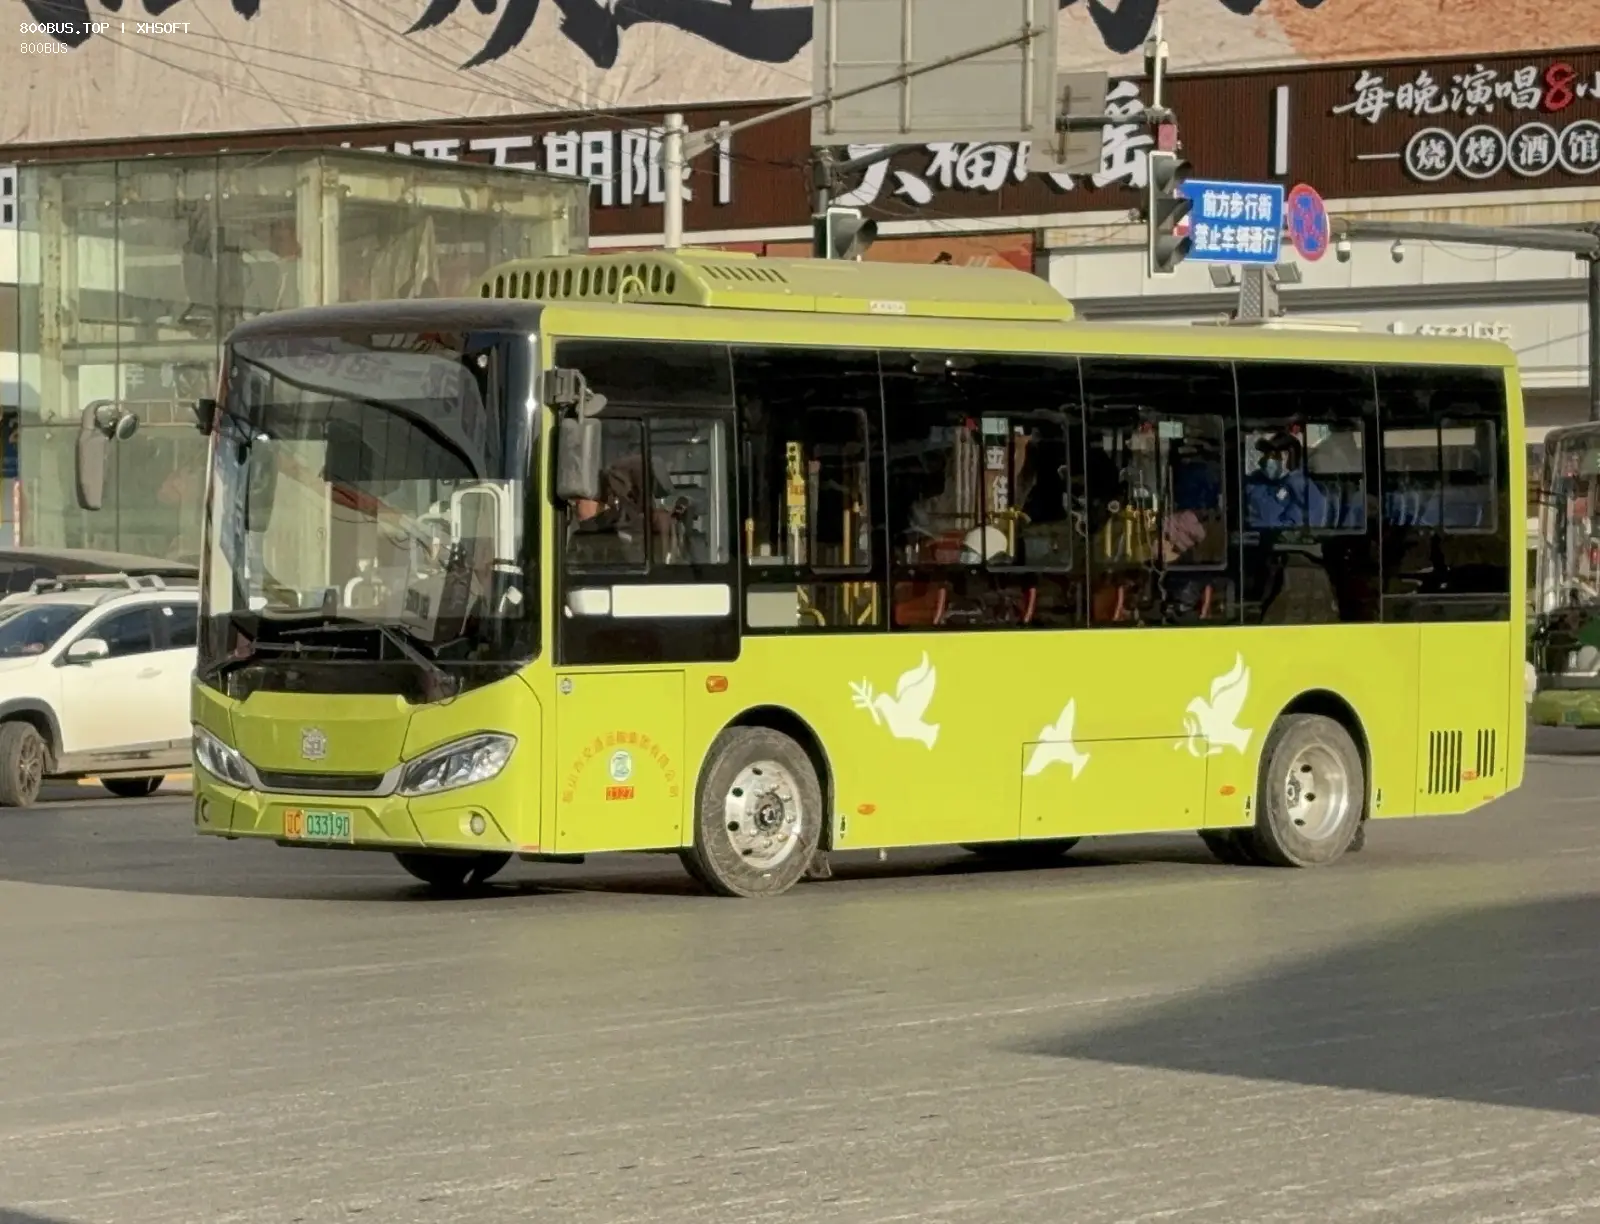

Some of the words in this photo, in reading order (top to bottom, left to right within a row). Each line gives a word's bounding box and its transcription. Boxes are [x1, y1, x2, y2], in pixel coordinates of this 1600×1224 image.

[1416, 129, 1600, 170] 烧烤酒馆
[1202, 189, 1273, 222] 前方步行街
[1194, 223, 1277, 255] 禁止车辆通行
